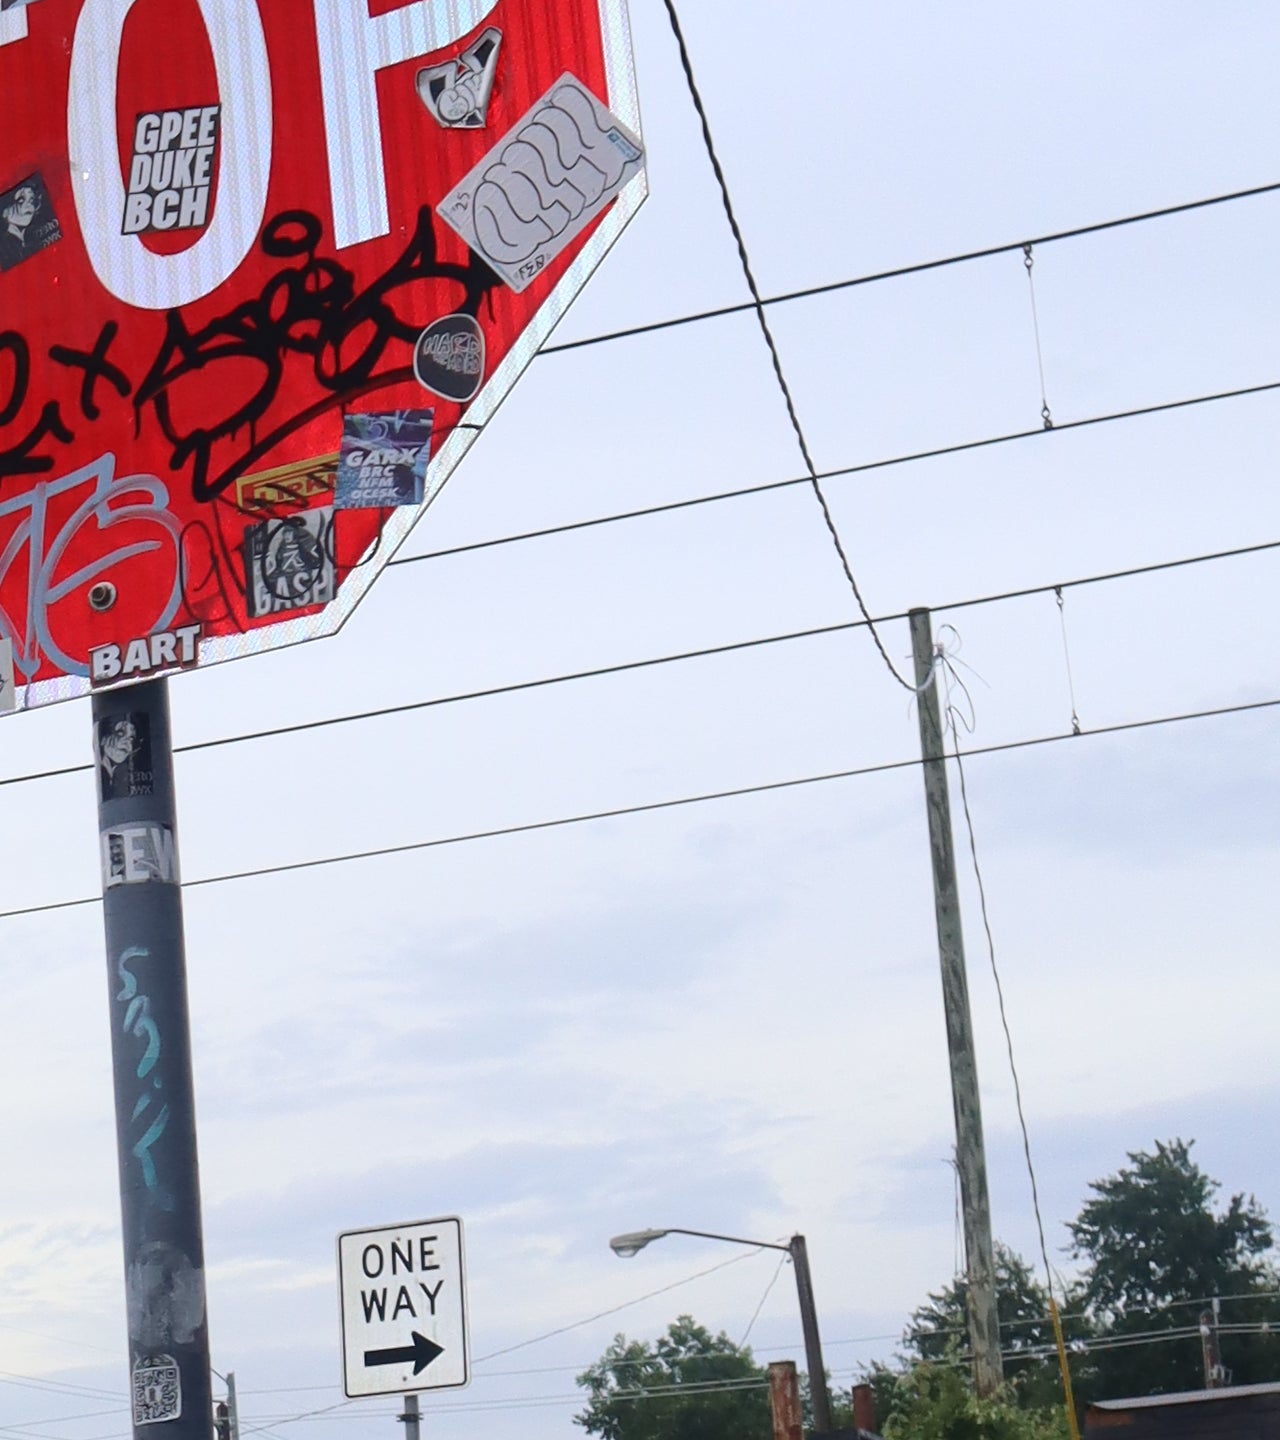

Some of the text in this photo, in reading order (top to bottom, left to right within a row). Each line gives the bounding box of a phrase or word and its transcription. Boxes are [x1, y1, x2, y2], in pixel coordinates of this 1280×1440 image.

[134, 106, 219, 154] GPEE
[129, 145, 214, 194] DUKE
[123, 185, 209, 233] BCH
[346, 446, 419, 468] GARX
[92, 623, 201, 682] BART
[362, 1236, 440, 1278] ONE
[361, 1279, 444, 1323] WAY
